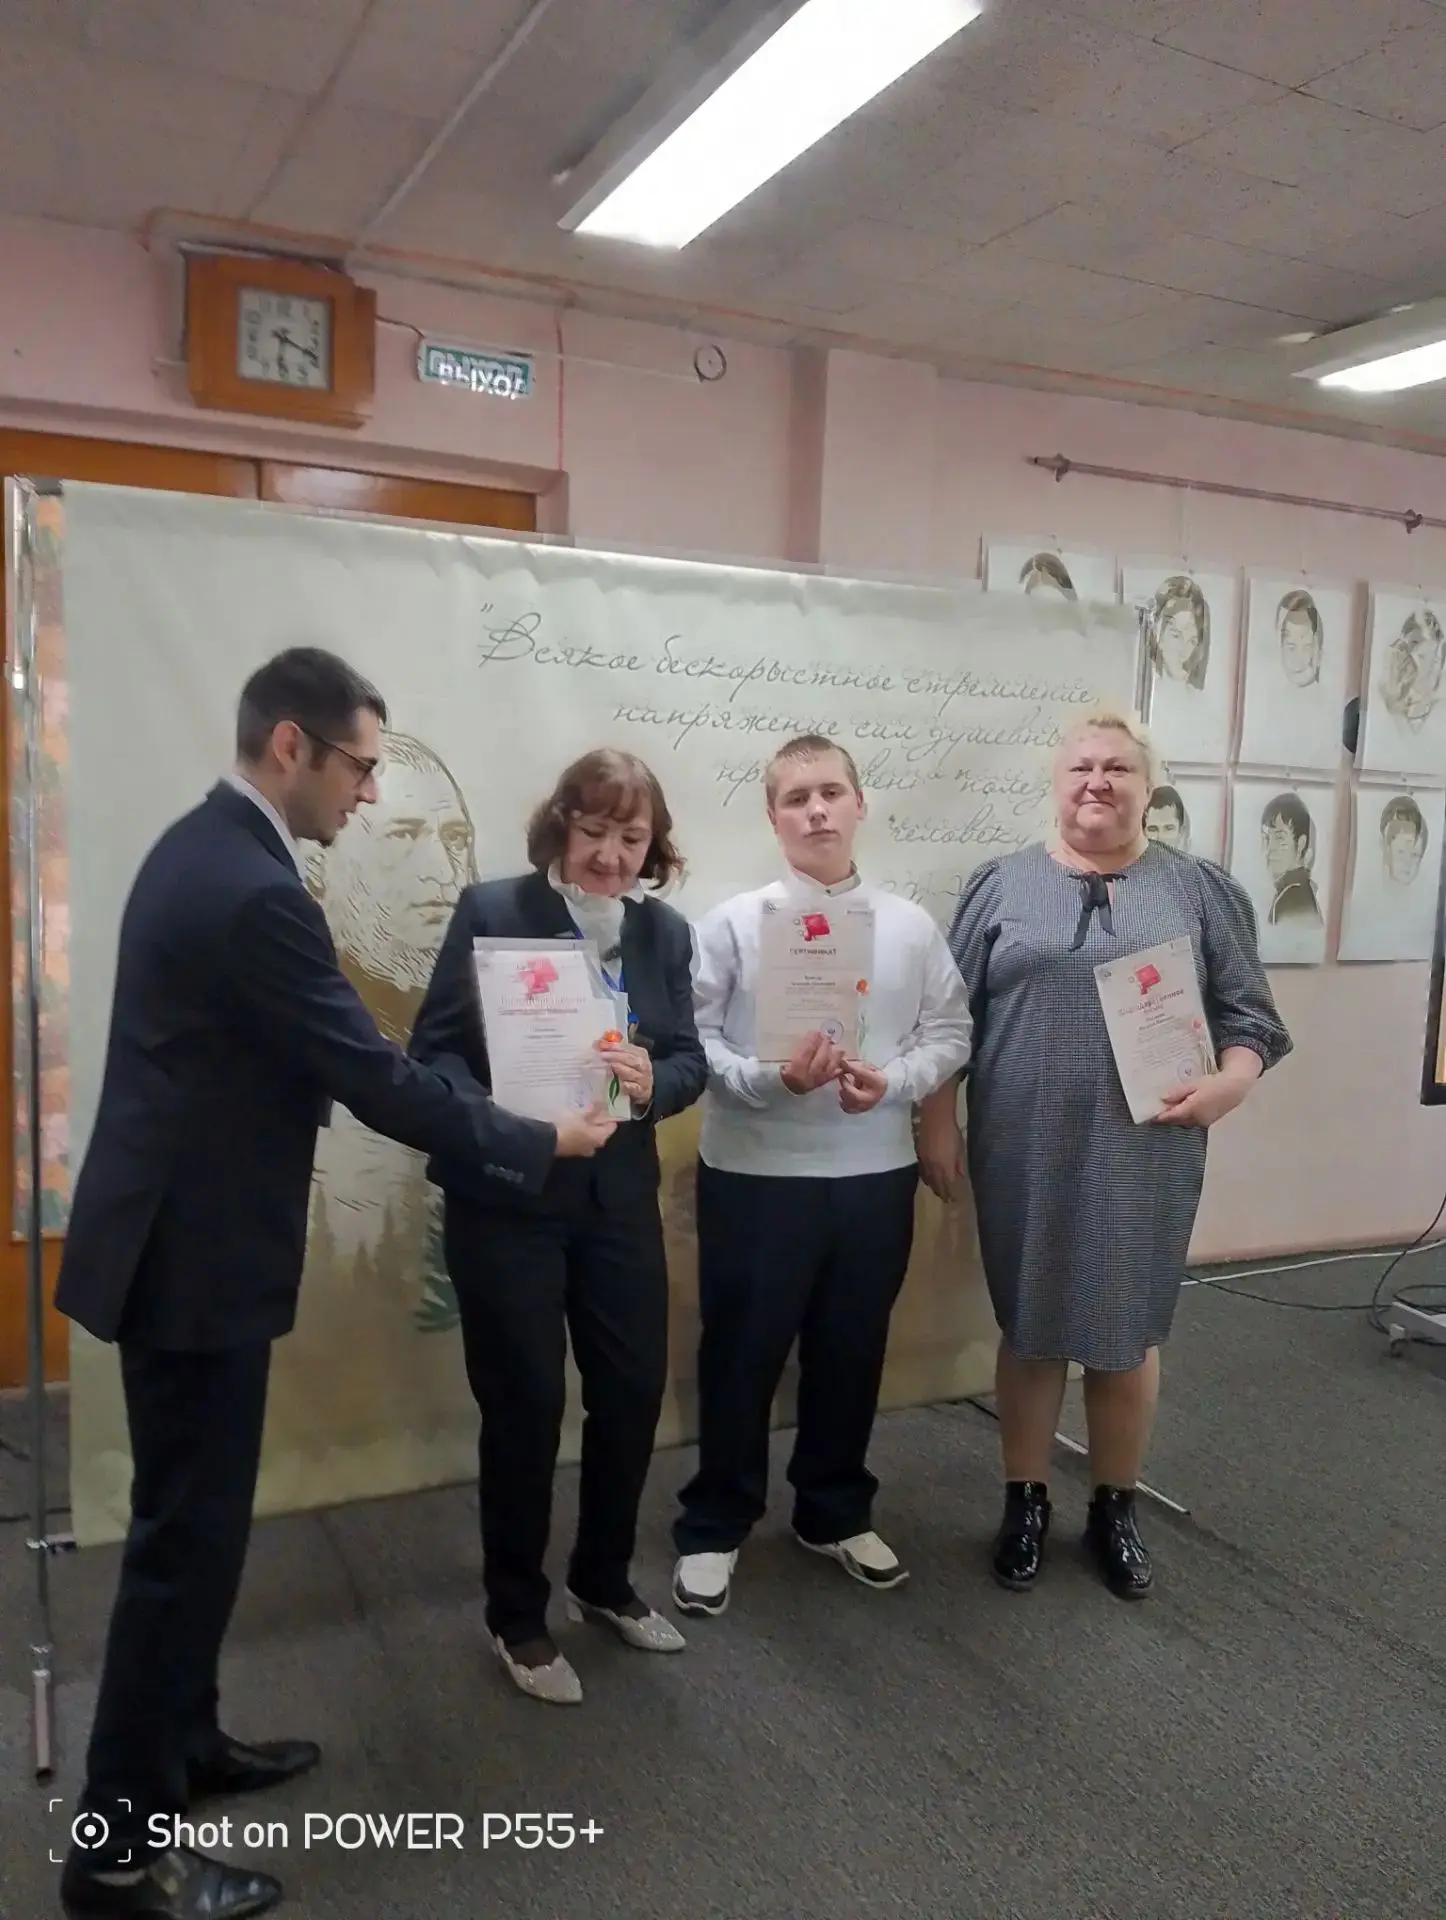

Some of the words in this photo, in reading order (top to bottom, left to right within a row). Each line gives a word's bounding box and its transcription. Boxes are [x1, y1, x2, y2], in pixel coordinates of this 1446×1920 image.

[655, 635, 896, 703] бескорыстное
[613, 703, 840, 751] напряжение
[854, 716, 917, 741] сил
